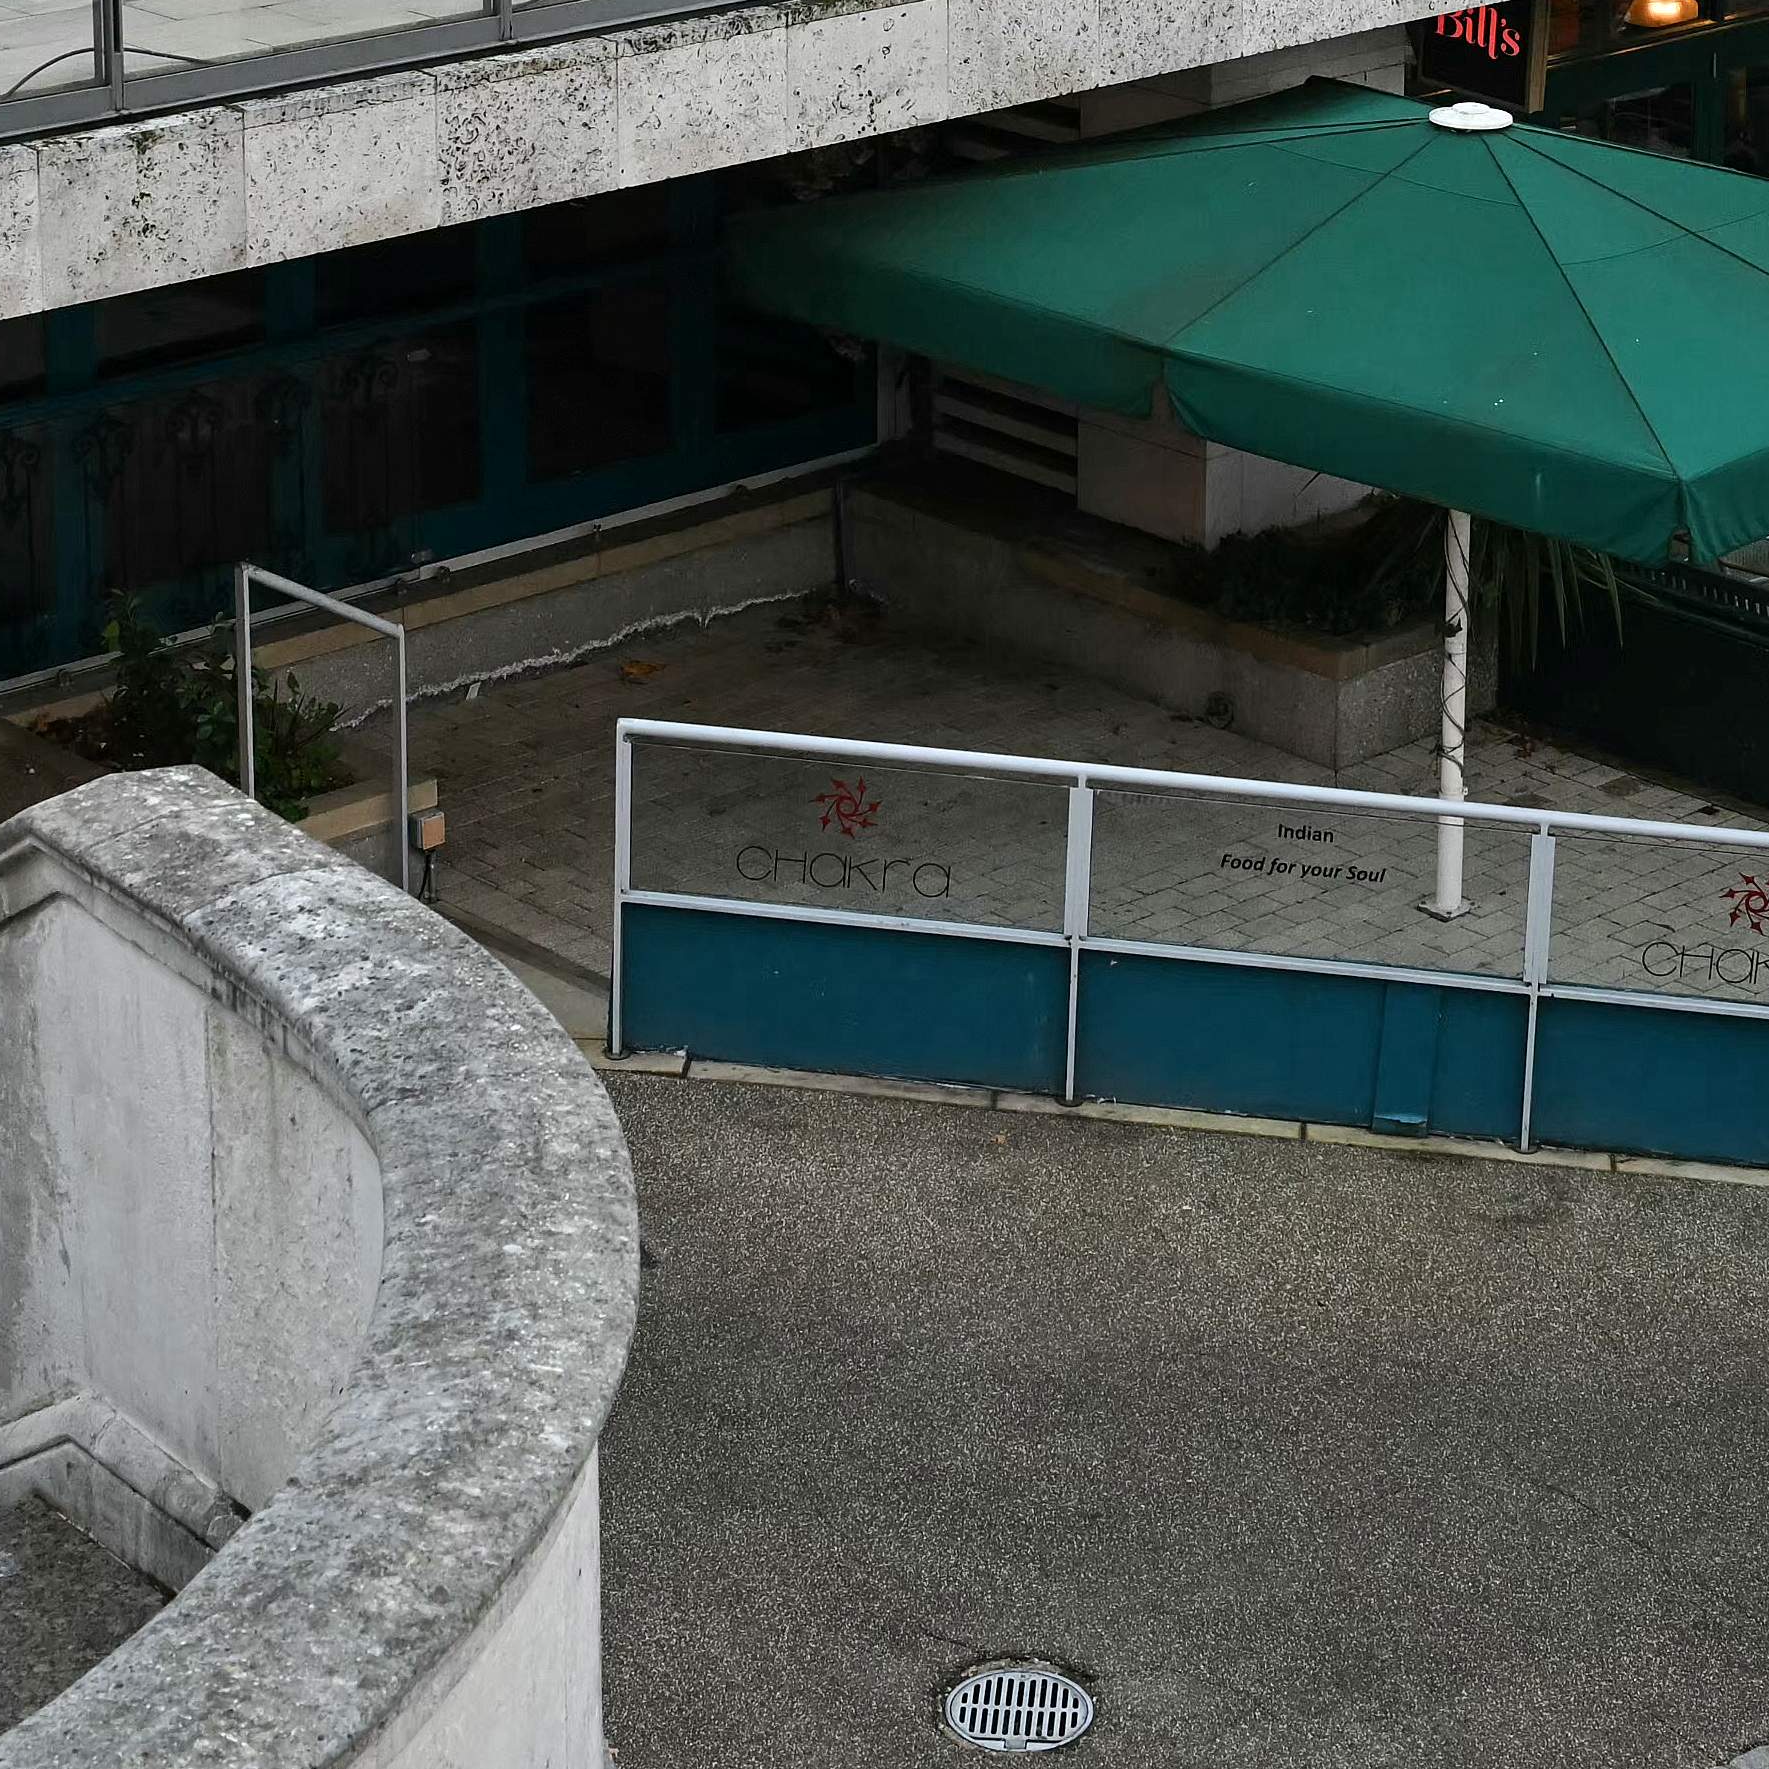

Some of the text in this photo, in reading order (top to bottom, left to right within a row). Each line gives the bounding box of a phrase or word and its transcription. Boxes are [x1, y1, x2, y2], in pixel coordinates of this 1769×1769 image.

[1435, 4, 1520, 60] Bill's
[1277, 824, 1334, 843] Indian
[1220, 854, 1387, 883] Food for your Soul
